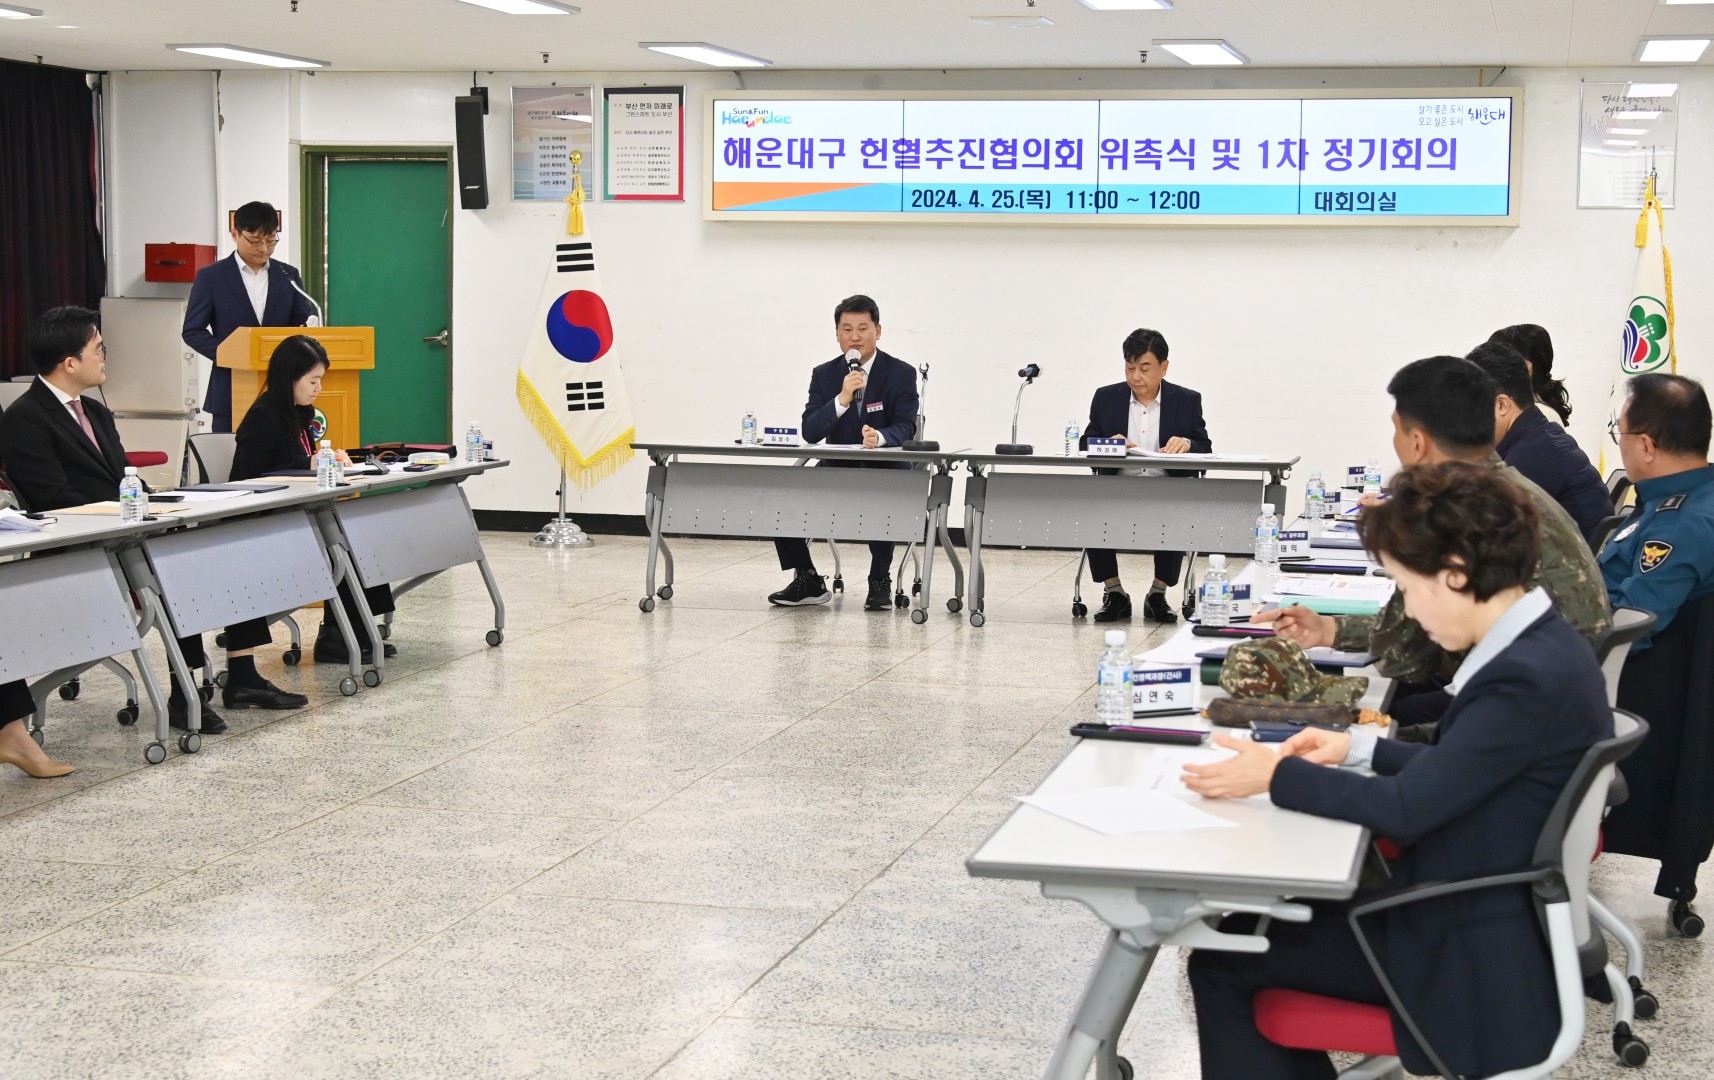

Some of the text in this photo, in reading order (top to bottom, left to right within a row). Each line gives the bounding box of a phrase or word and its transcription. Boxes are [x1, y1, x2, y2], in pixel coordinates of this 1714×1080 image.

[722, 110, 792, 128] Haeundae
[1418, 105, 1464, 115] 살기 좋은 도시
[1418, 117, 1463, 127] 오고 싶은 도시
[723, 137, 1458, 171] 해운대구 헌혈추진협의회 위촉식 및 1차 정기회의
[911, 190, 962, 208] 2024.
[968, 190, 984, 208] 4.
[1066, 190, 1118, 210] 11:00
[1149, 190, 1200, 210] 12:00
[1314, 191, 1397, 212] 대회의실
